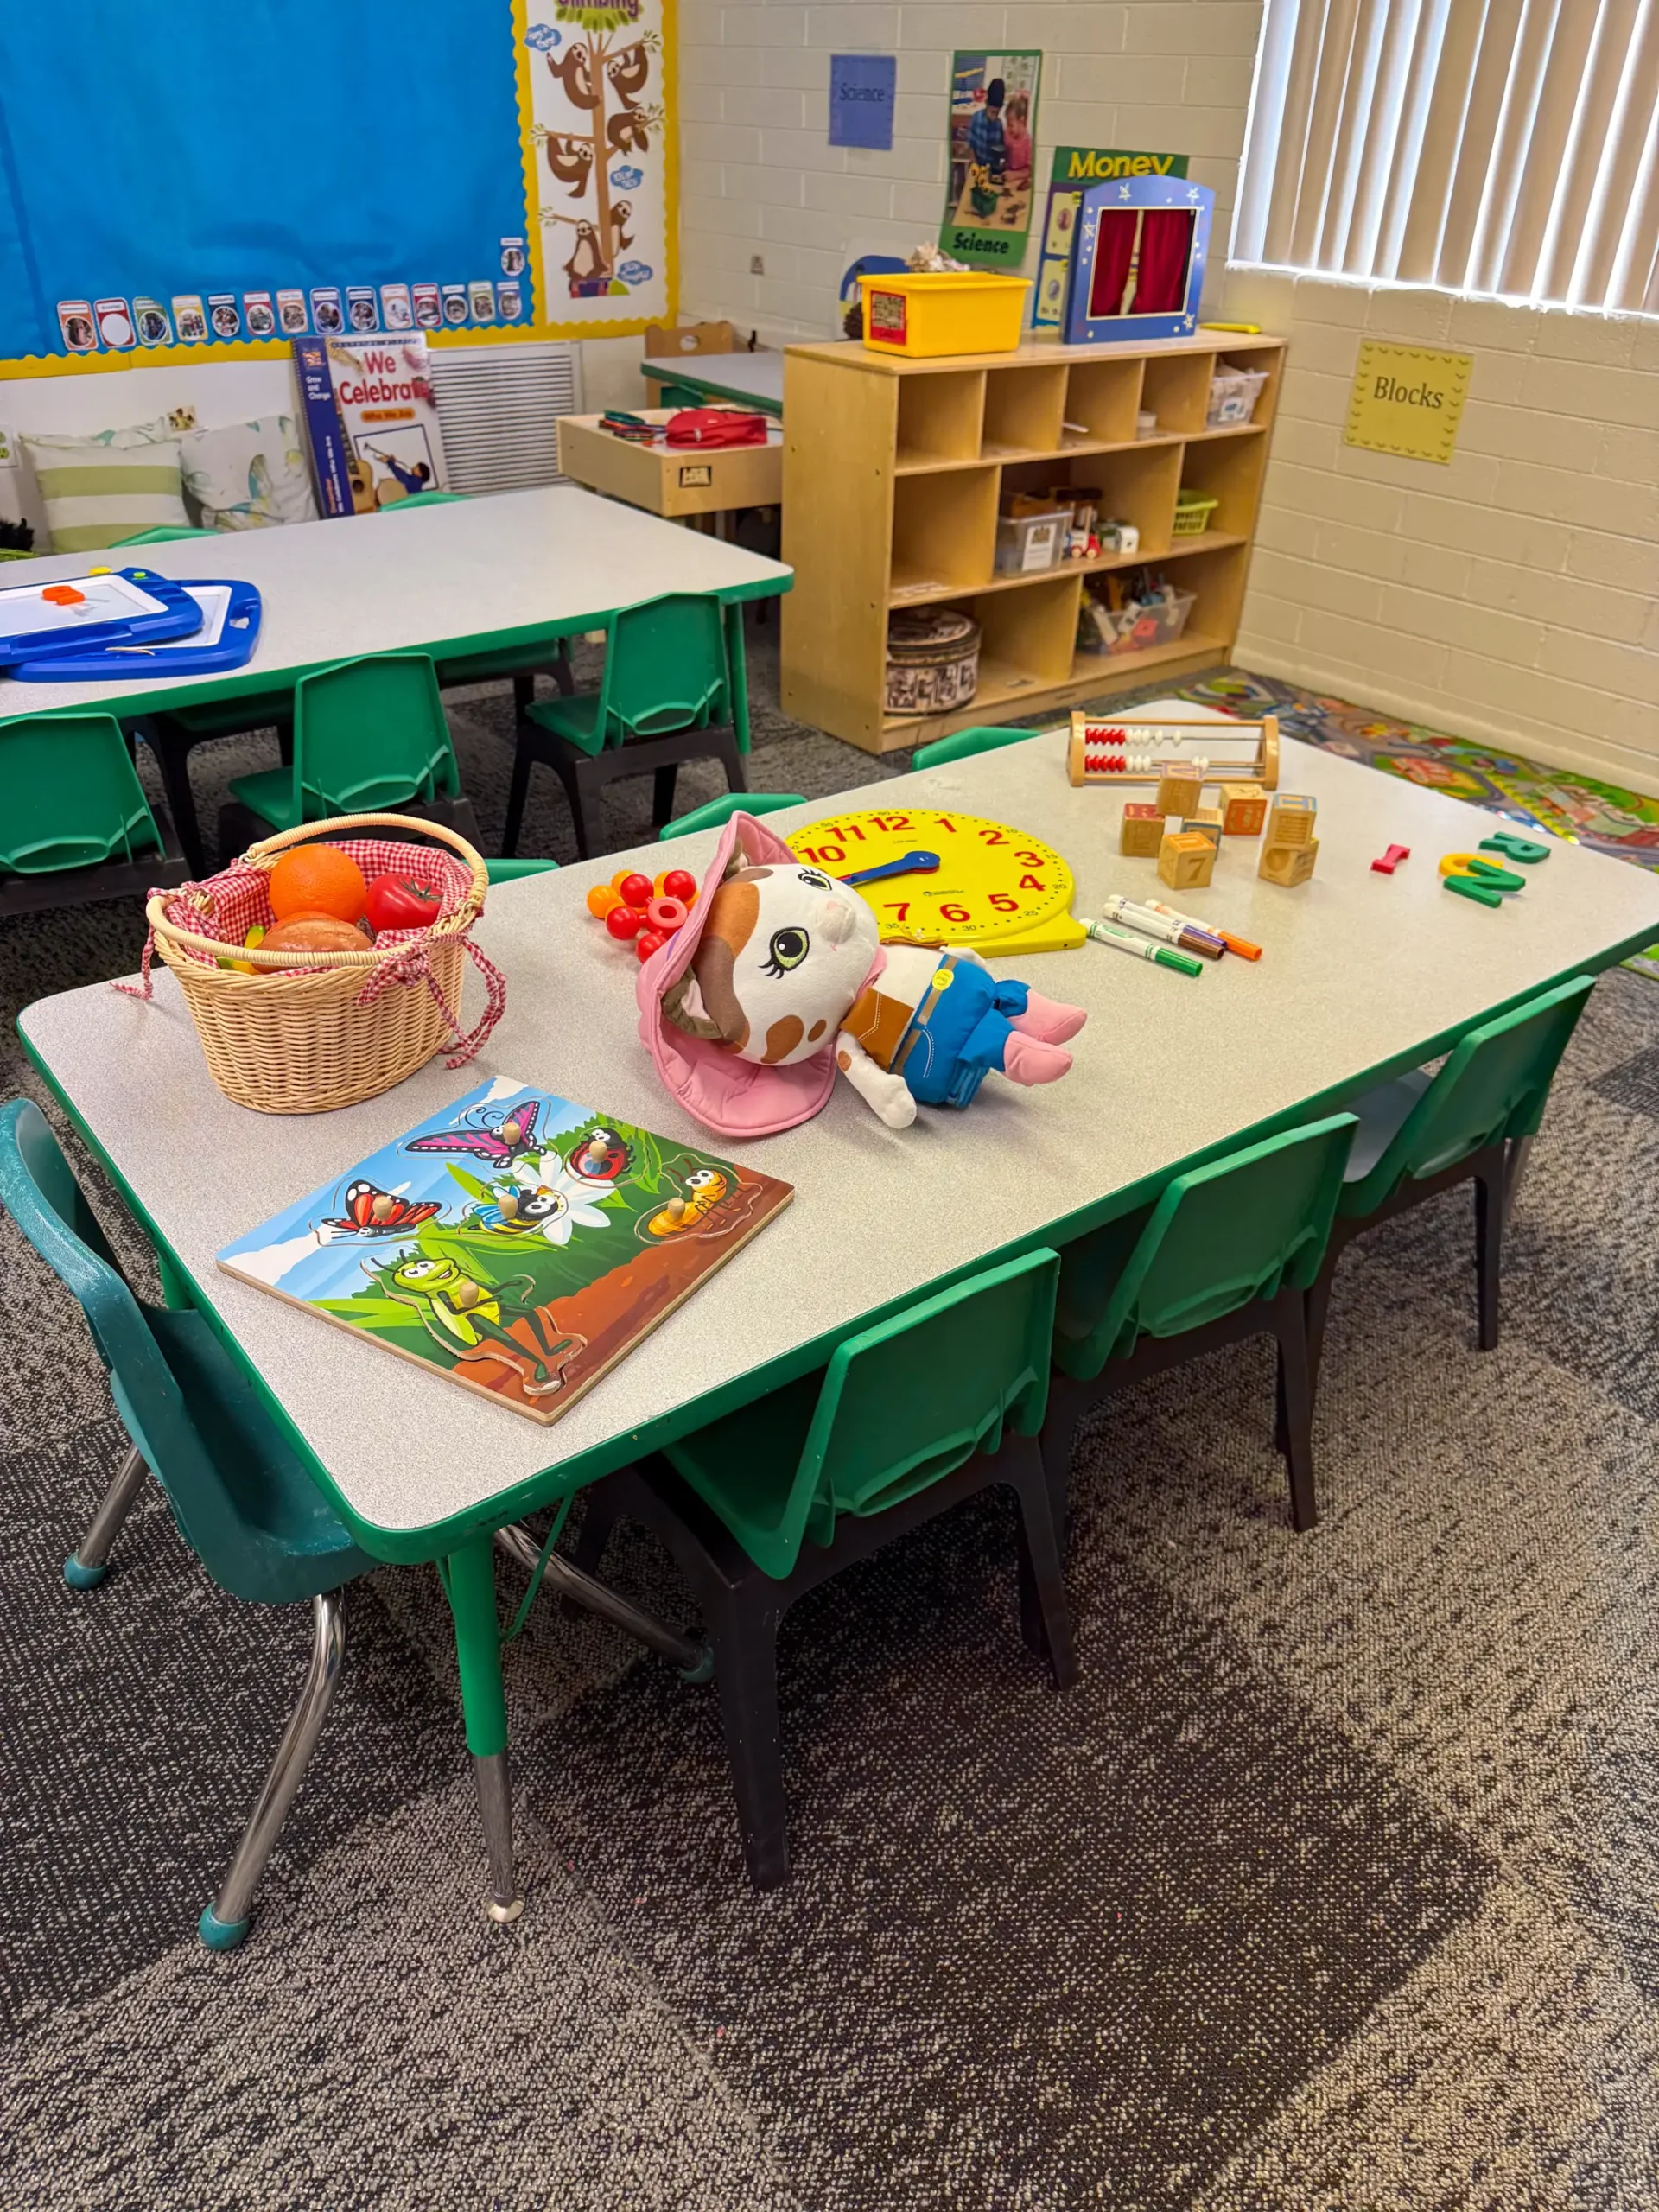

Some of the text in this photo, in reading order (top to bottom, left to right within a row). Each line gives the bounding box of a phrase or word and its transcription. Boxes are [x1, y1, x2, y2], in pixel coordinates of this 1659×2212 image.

[839, 83, 886, 102] Science
[1068, 151, 1174, 178] Money
[953, 232, 1009, 253] Science
[364, 350, 397, 374] We
[1373, 376, 1444, 409] Blocks
[824, 825, 867, 842] 11
[867, 816, 916, 832] 12
[933, 818, 957, 833] 1
[978, 830, 1010, 846] 2
[798, 845, 846, 864] 10
[1014, 851, 1046, 868] 3
[1187, 857, 1207, 881] 7
[1019, 874, 1046, 892] 4
[883, 902, 911, 922] 7
[988, 893, 1020, 912] 5
[939, 903, 971, 923] 6
